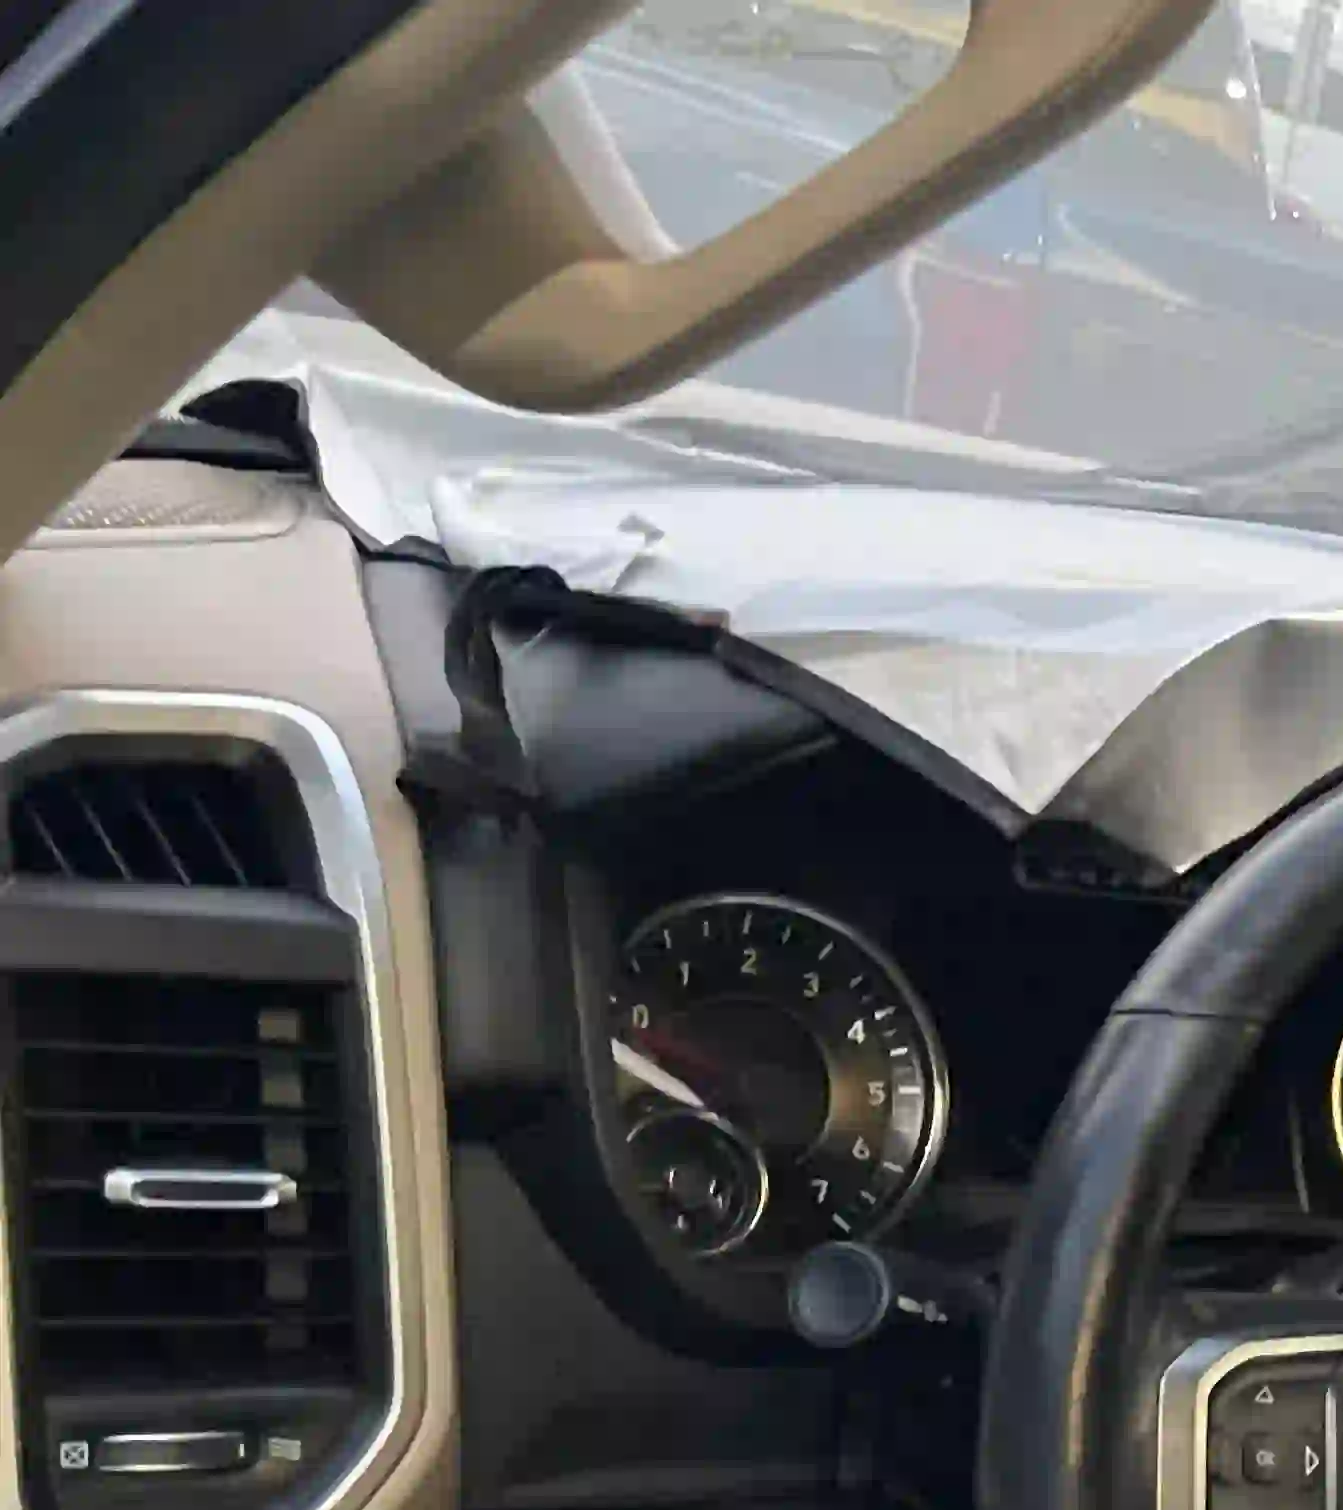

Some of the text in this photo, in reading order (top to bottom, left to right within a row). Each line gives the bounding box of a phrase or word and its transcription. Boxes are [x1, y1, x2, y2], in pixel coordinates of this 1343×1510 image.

[741, 948, 757, 975] 2
[803, 972, 820, 998] 3
[632, 1004, 649, 1029] 0
[847, 1019, 865, 1044] 4
[867, 1081, 886, 1105] 5
[852, 1136, 870, 1160] 6
[811, 1178, 829, 1204] 7
